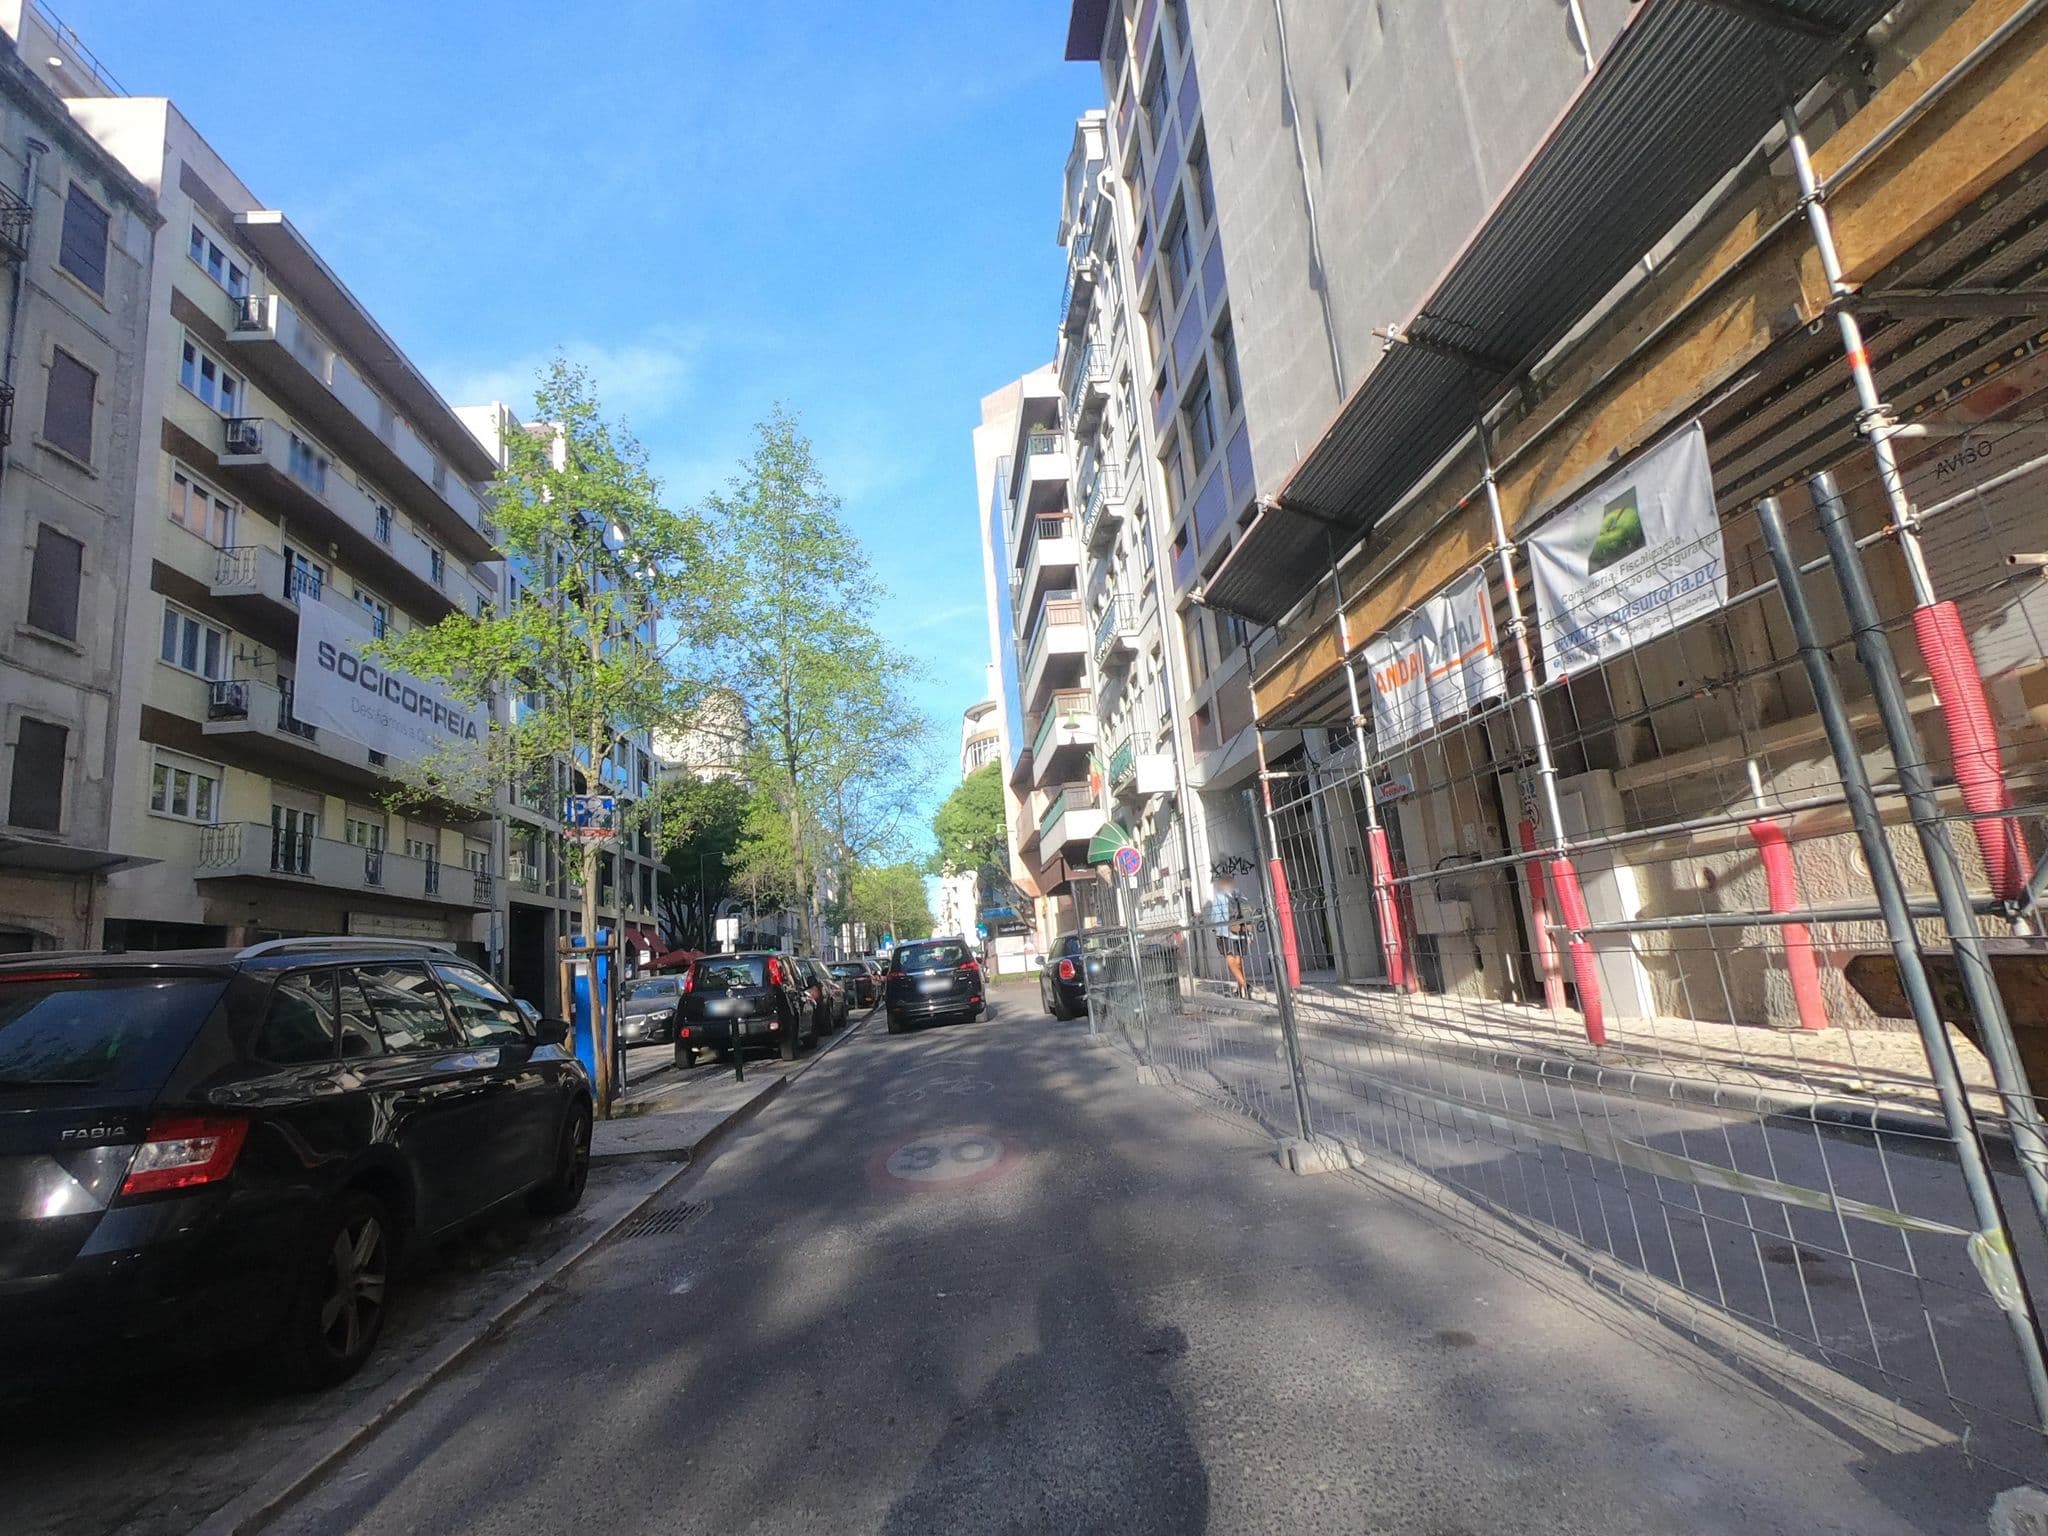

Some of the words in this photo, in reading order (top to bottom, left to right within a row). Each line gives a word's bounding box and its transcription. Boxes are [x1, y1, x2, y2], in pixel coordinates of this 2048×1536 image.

[1936, 440, 1992, 480] AVISO
[318, 640, 479, 744] SOCICORREIA
[61, 1125, 126, 1141] FABIA
[898, 1137, 993, 1171] 30
